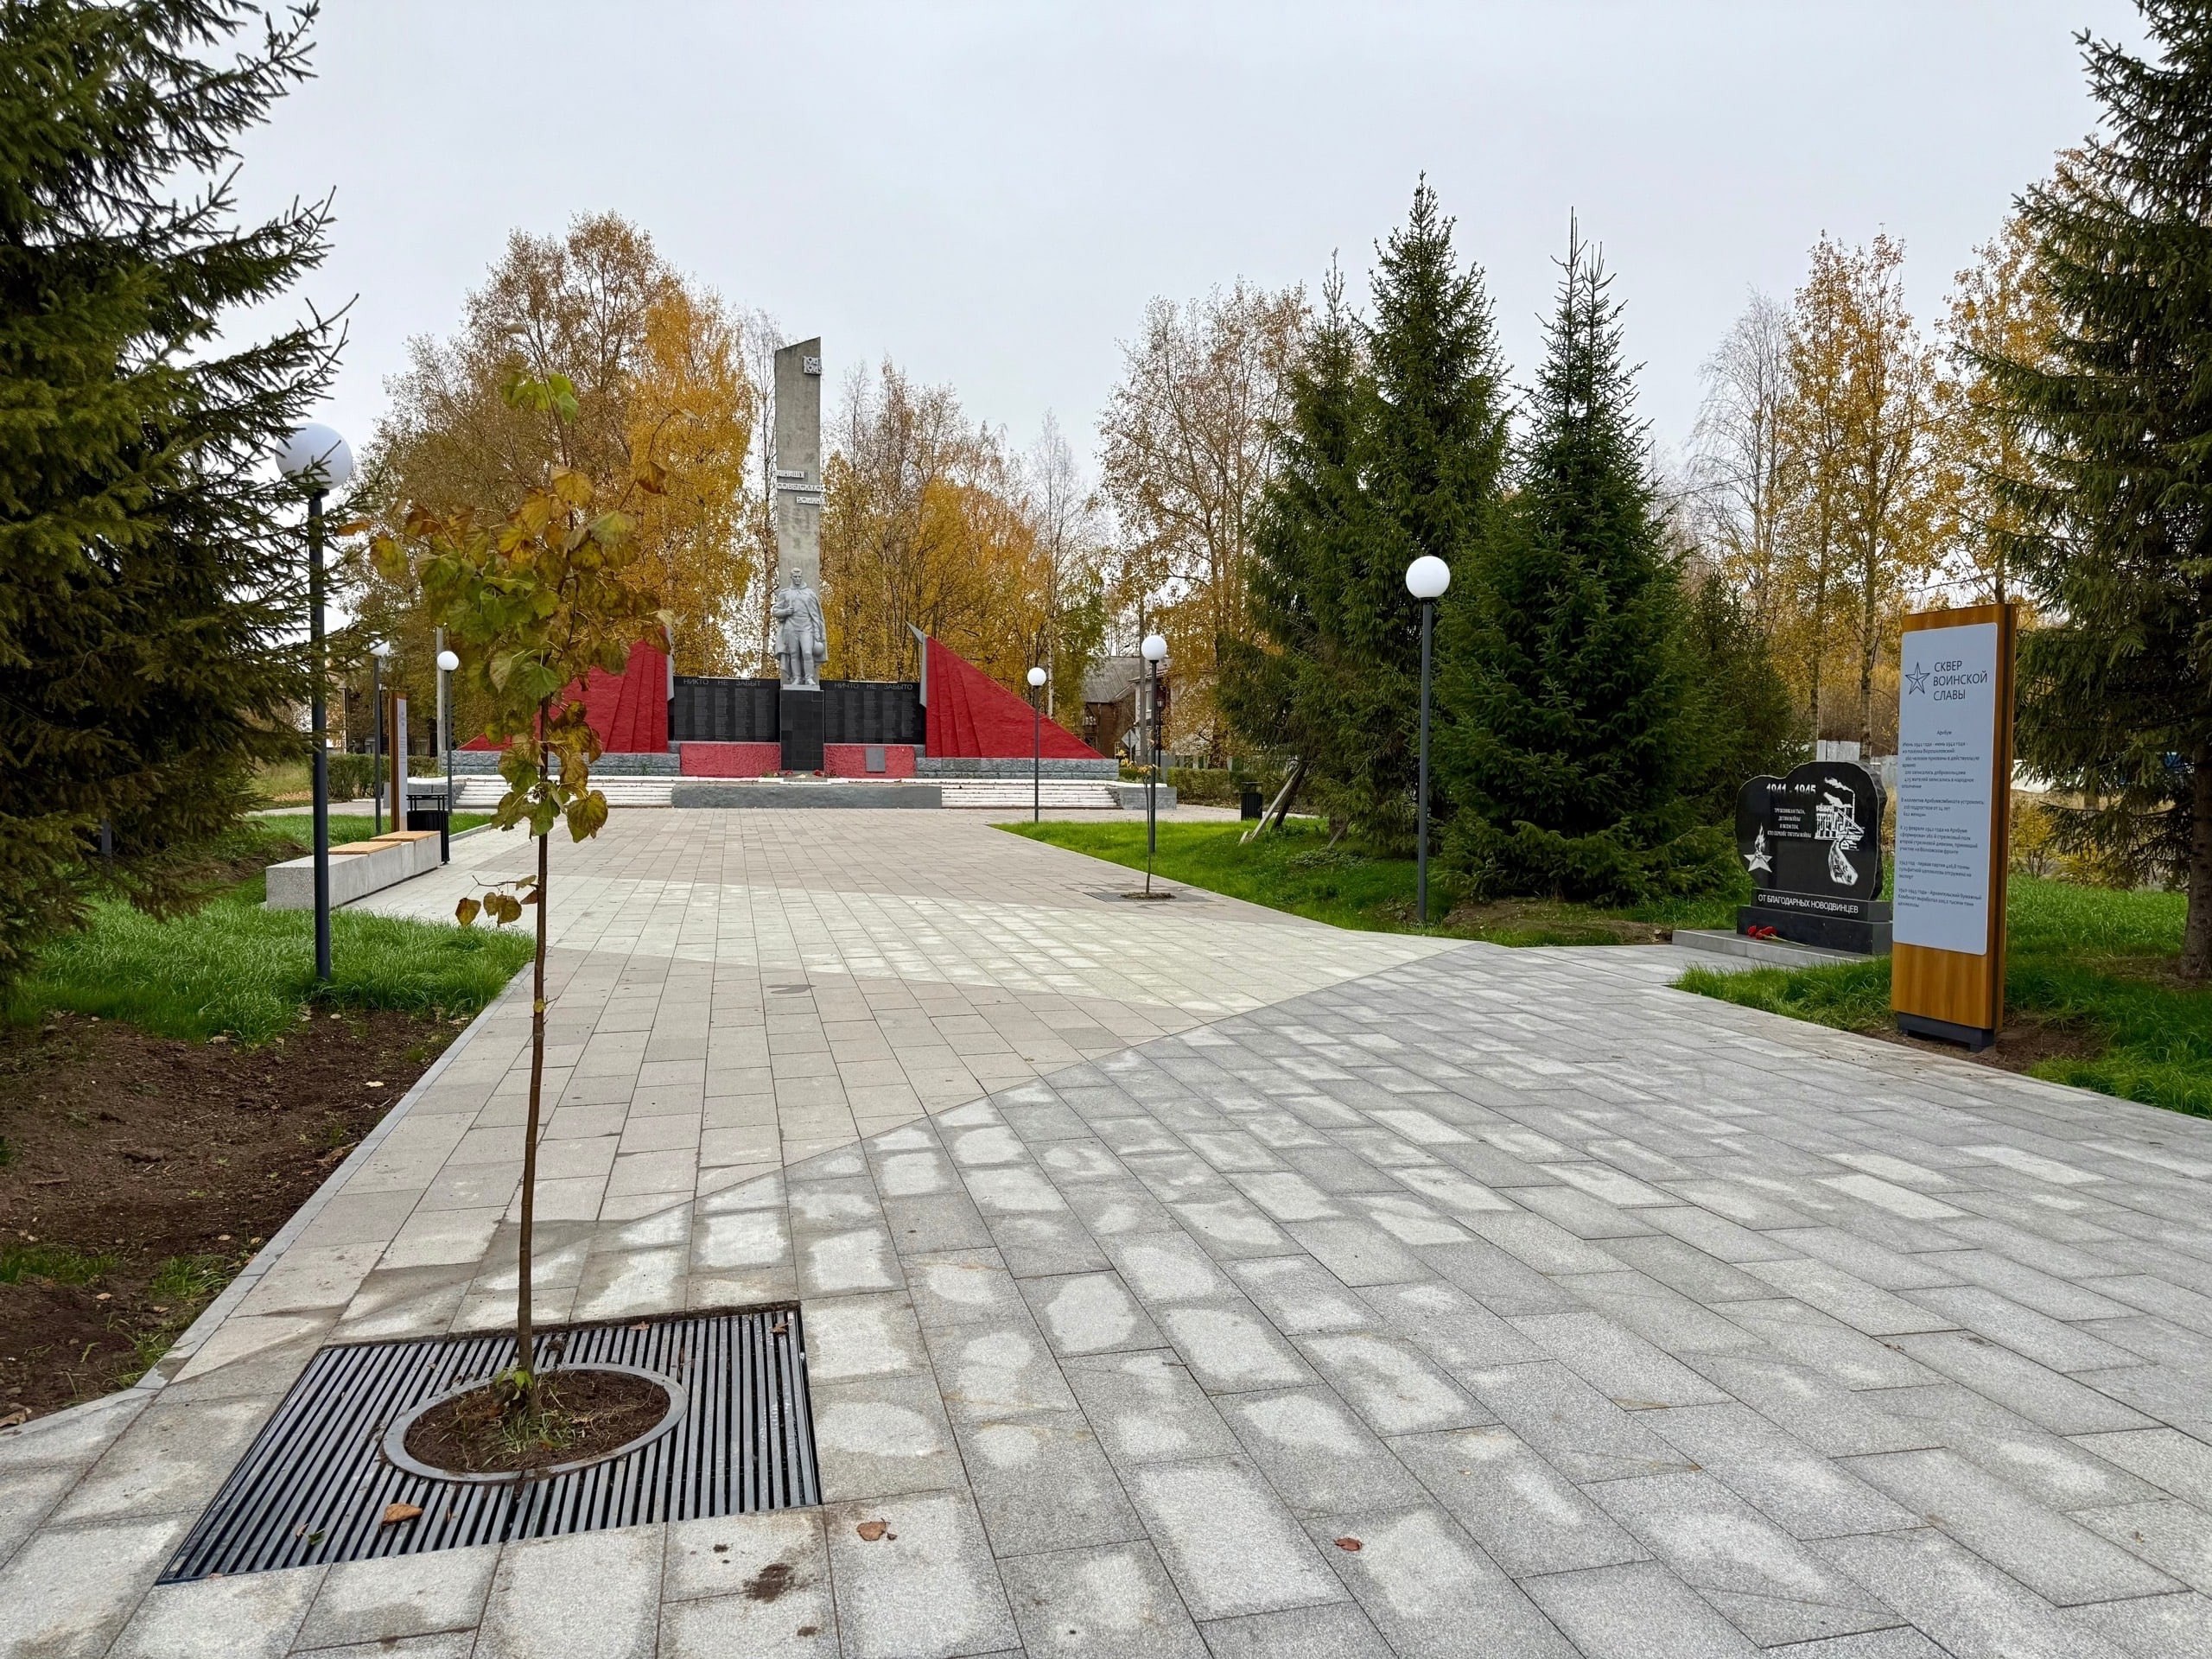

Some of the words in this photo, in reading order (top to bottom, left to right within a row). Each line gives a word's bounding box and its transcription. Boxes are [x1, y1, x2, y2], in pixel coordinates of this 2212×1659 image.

[1935, 660, 1962, 672] СКВЕР
[1934, 671, 1987, 686] ВОИНСКОЙ
[1934, 689, 1966, 701] СЛАВЫ
[1767, 895, 1810, 908] БЛАГОДАРНЫХ
[1811, 900, 1859, 914] НОВОДВИНЦЕВ
